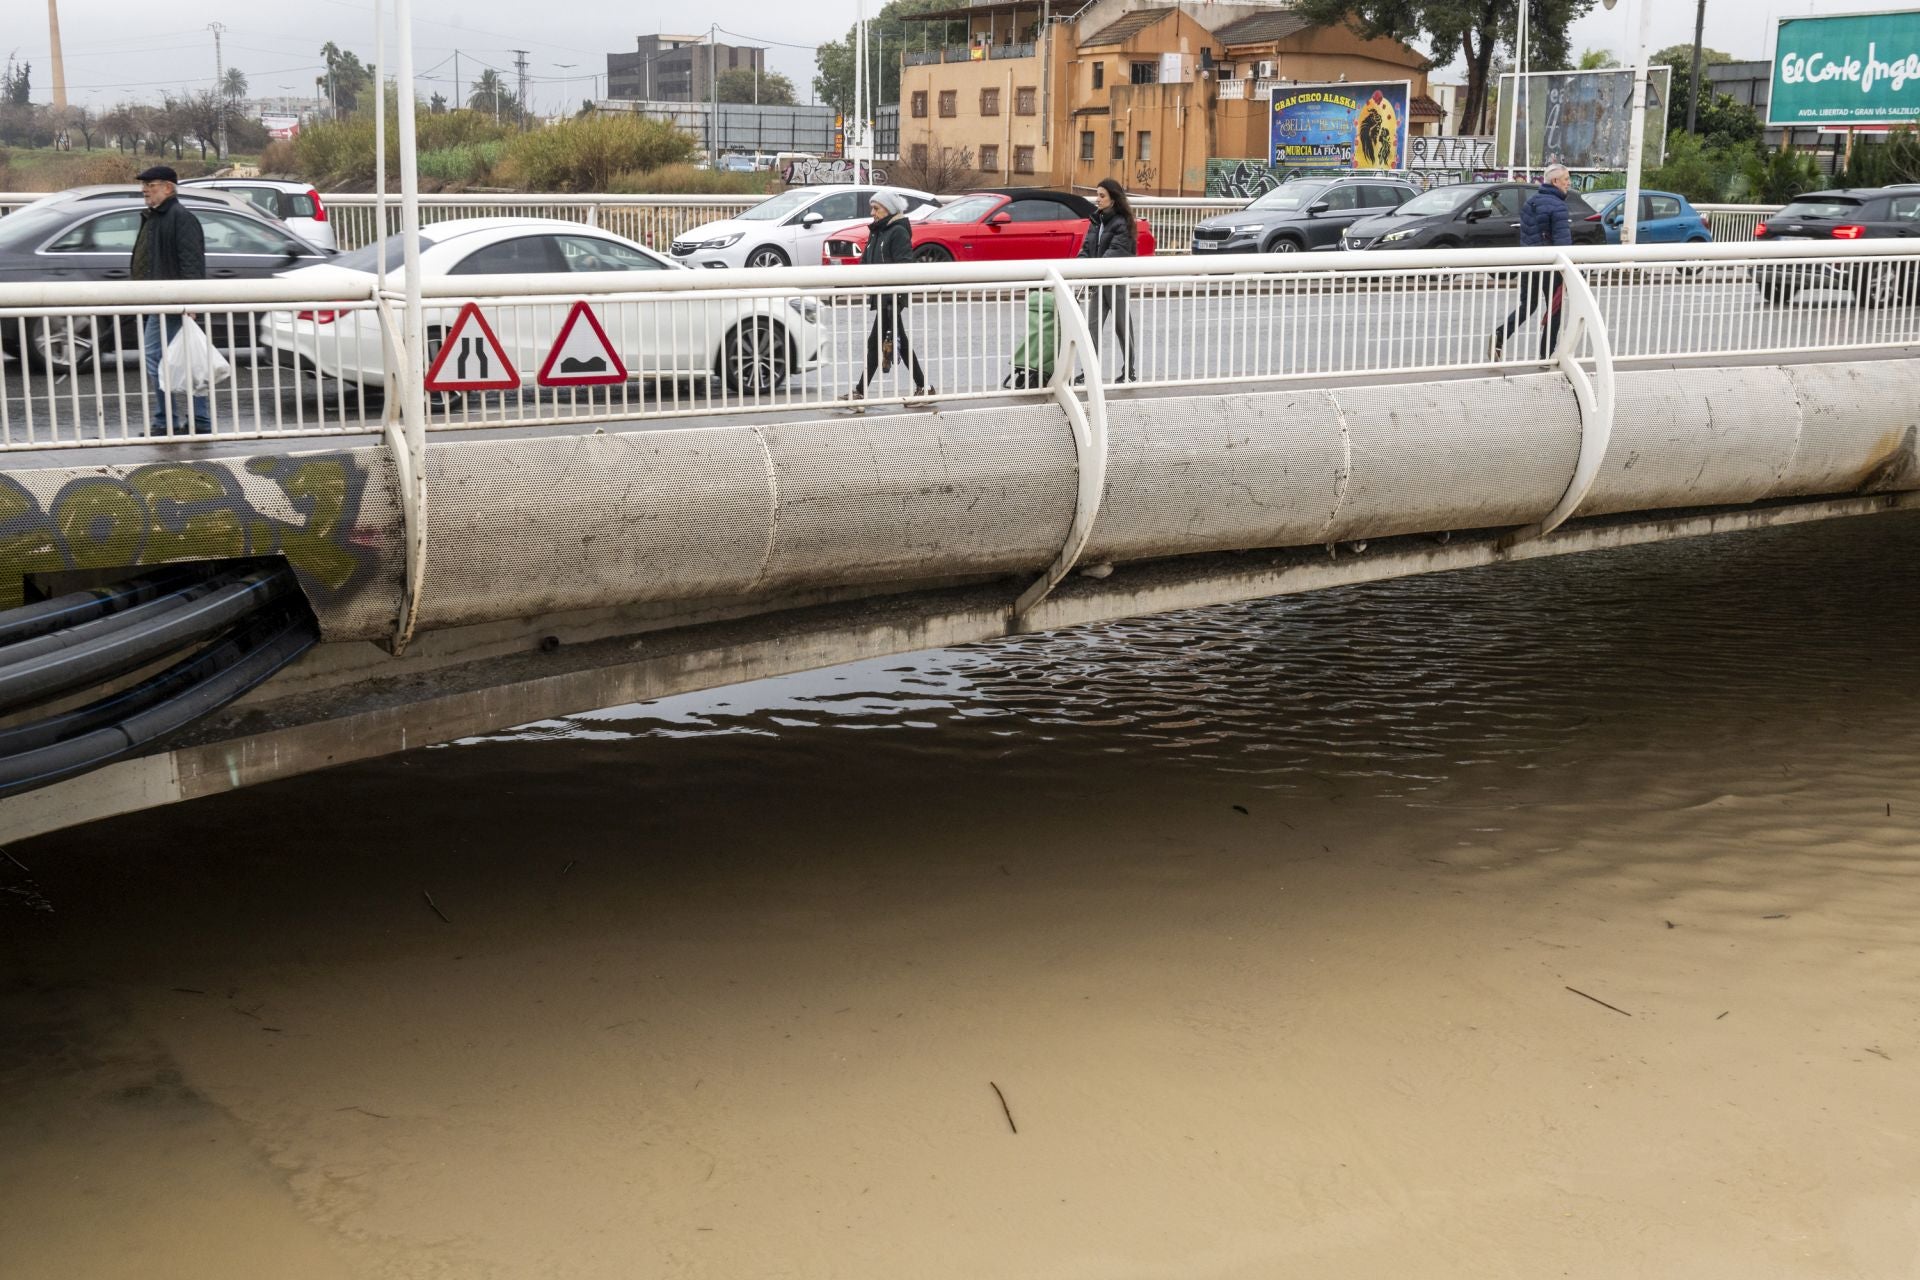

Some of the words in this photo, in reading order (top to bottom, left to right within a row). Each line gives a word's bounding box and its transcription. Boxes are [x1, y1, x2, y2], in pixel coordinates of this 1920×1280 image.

[1782, 52, 1805, 84] El
[1805, 52, 1861, 83] Corte
[1274, 96, 1297, 112] GRAN
[1298, 92, 1322, 104] CIRCO
[1323, 93, 1357, 110] ALASKA
[1798, 109, 1818, 117] AVDA.
[1819, 108, 1849, 116] LIBERTAD
[1855, 108, 1874, 116] GRAN
[1875, 106, 1887, 115] VÍA
[1888, 107, 1920, 115] SALZILLO
[1276, 149, 1285, 160] 28
[1285, 145, 1313, 156] MURCIA
[1313, 147, 1322, 156] LA
[1341, 147, 1351, 160] 16
